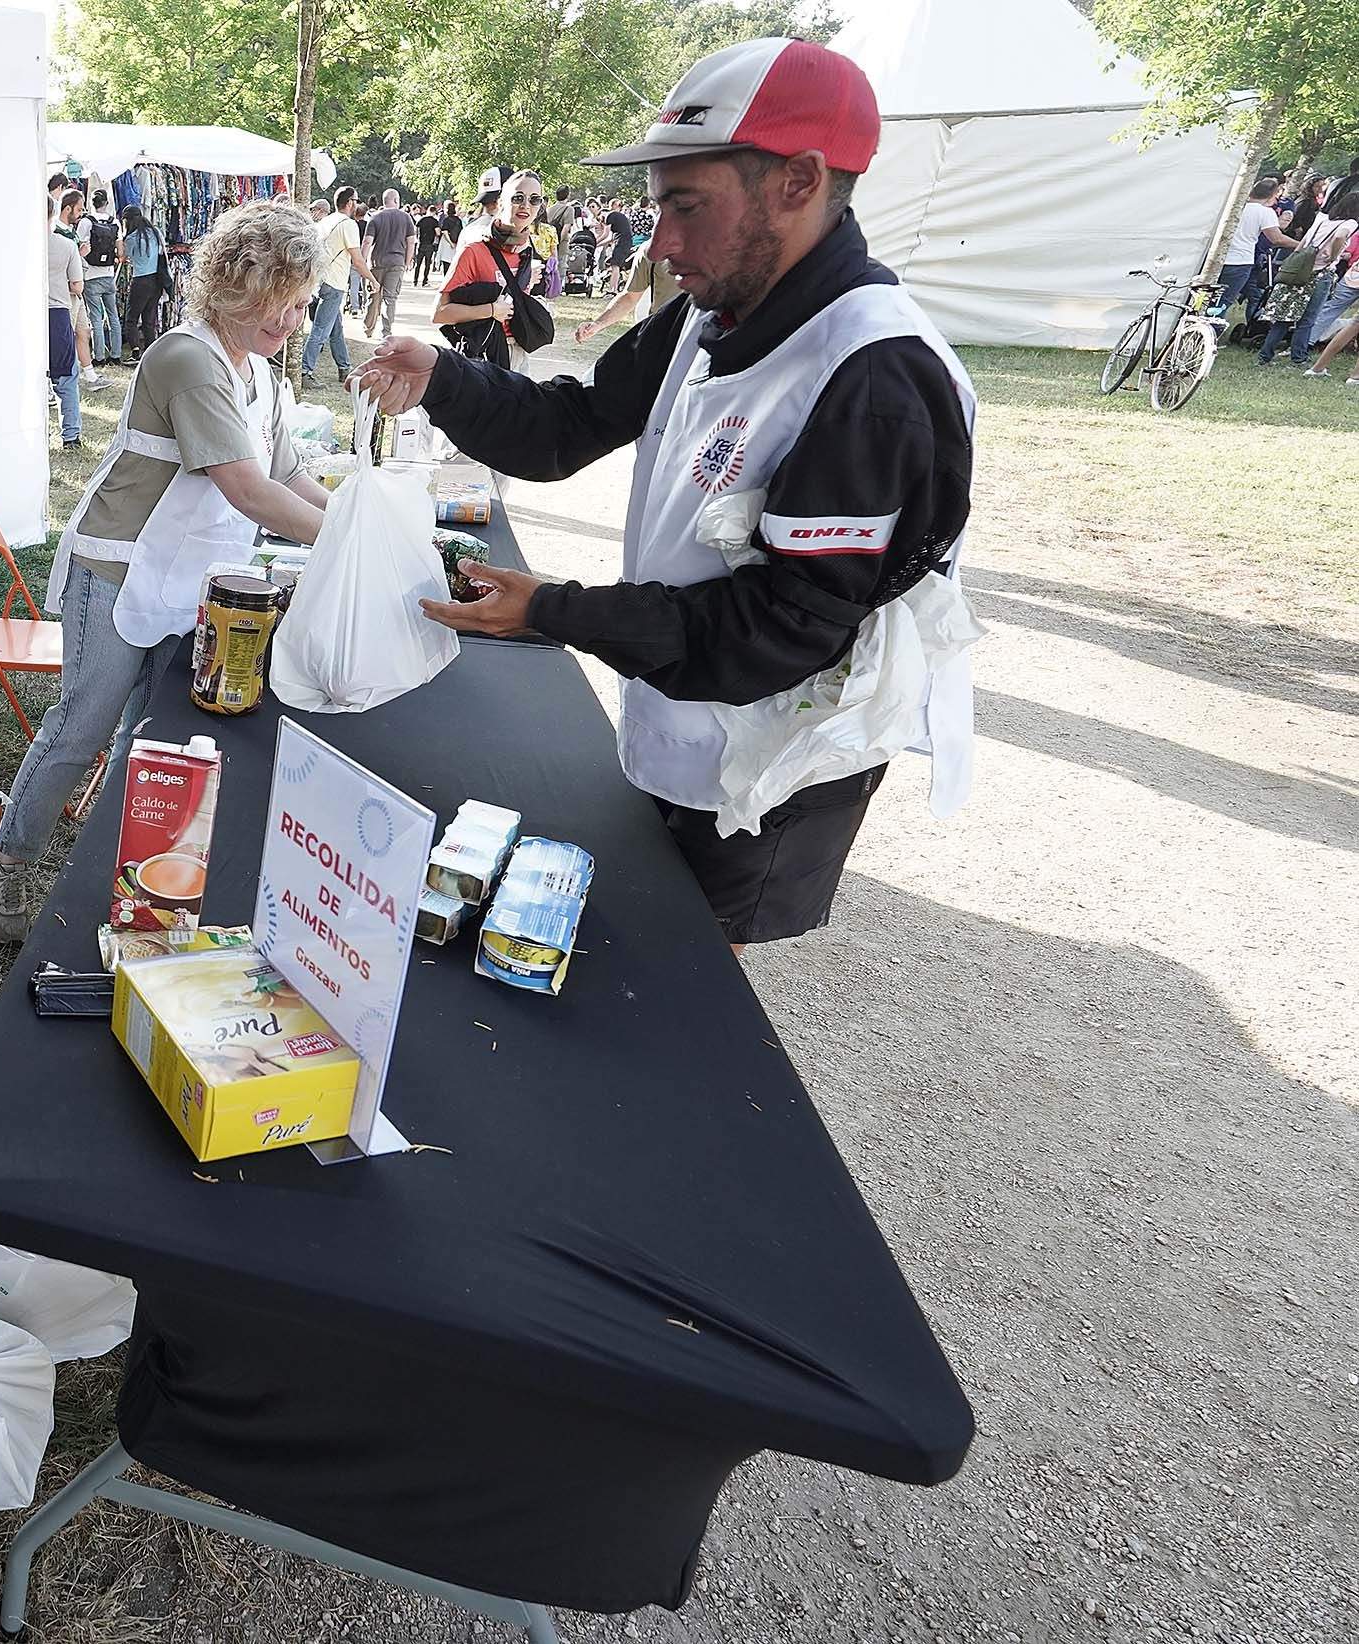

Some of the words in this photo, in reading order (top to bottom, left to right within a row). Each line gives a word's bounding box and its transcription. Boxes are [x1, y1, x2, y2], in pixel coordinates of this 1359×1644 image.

[789, 527, 878, 538] ONEX
[149, 770, 185, 786] eliges
[130, 807, 165, 820] Carne
[131, 795, 166, 809] Caldo
[166, 801, 179, 811] de
[280, 811, 397, 925] RECOLLIDA
[318, 884, 341, 916] DE
[281, 889, 372, 982] ALIMENTOS
[295, 946, 342, 998] Grazas!
[214, 1012, 283, 1051] Puré
[262, 1113, 314, 1145] Puré
